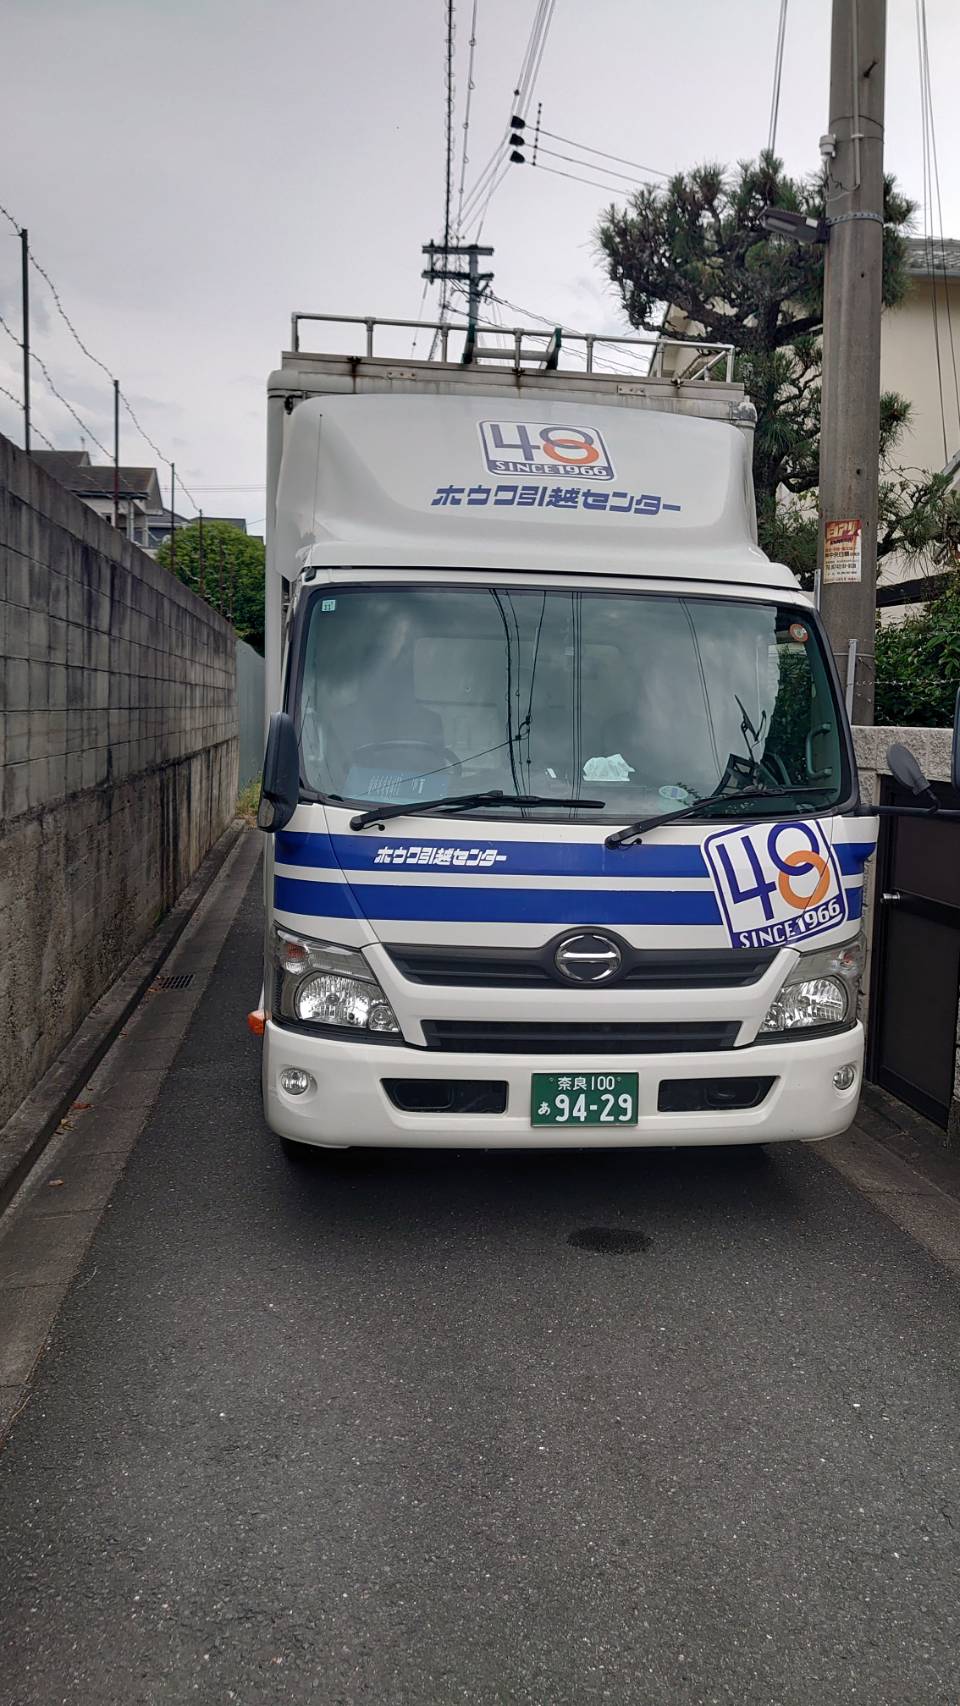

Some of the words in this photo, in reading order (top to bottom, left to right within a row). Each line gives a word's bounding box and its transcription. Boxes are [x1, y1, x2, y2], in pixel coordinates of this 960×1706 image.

[490, 423, 600, 465] 48
[716, 821, 830, 921] 48
[537, 1100, 551, 1116] あ
[555, 1093, 632, 1122] 94-29
